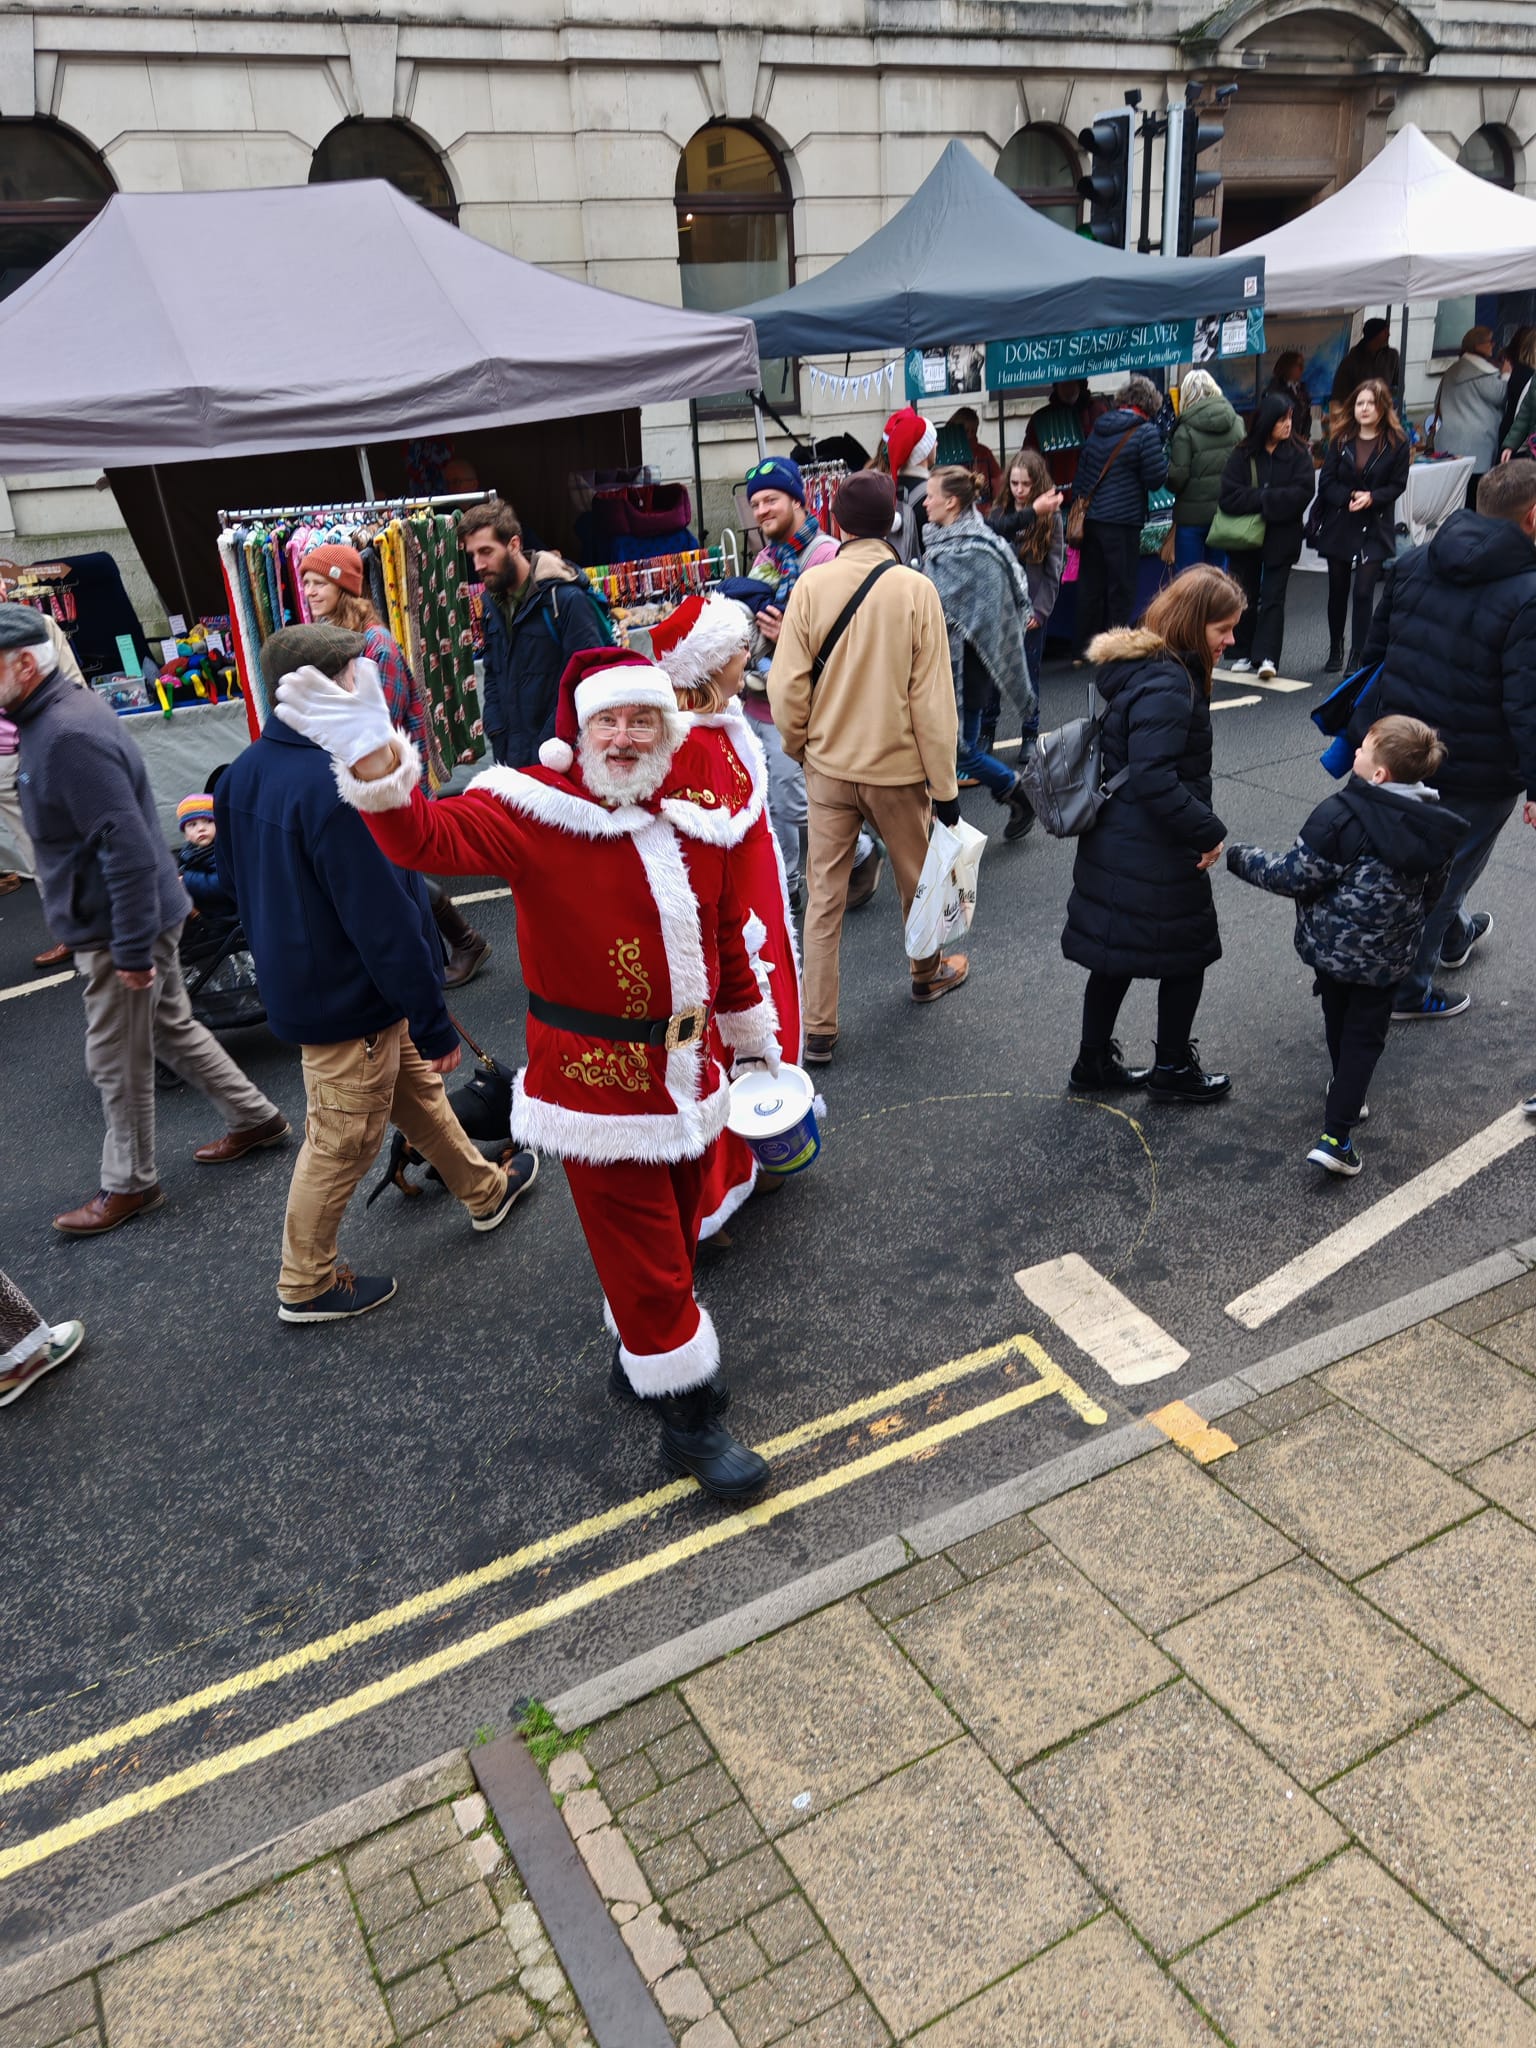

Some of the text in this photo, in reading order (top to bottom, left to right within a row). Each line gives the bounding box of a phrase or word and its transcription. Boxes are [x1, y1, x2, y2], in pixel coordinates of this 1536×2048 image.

[1005, 323, 1180, 365] DORSET SEASIDE SILVER
[997, 347, 1183, 385] Handmade Fine and Sterling Silver Jewellery
